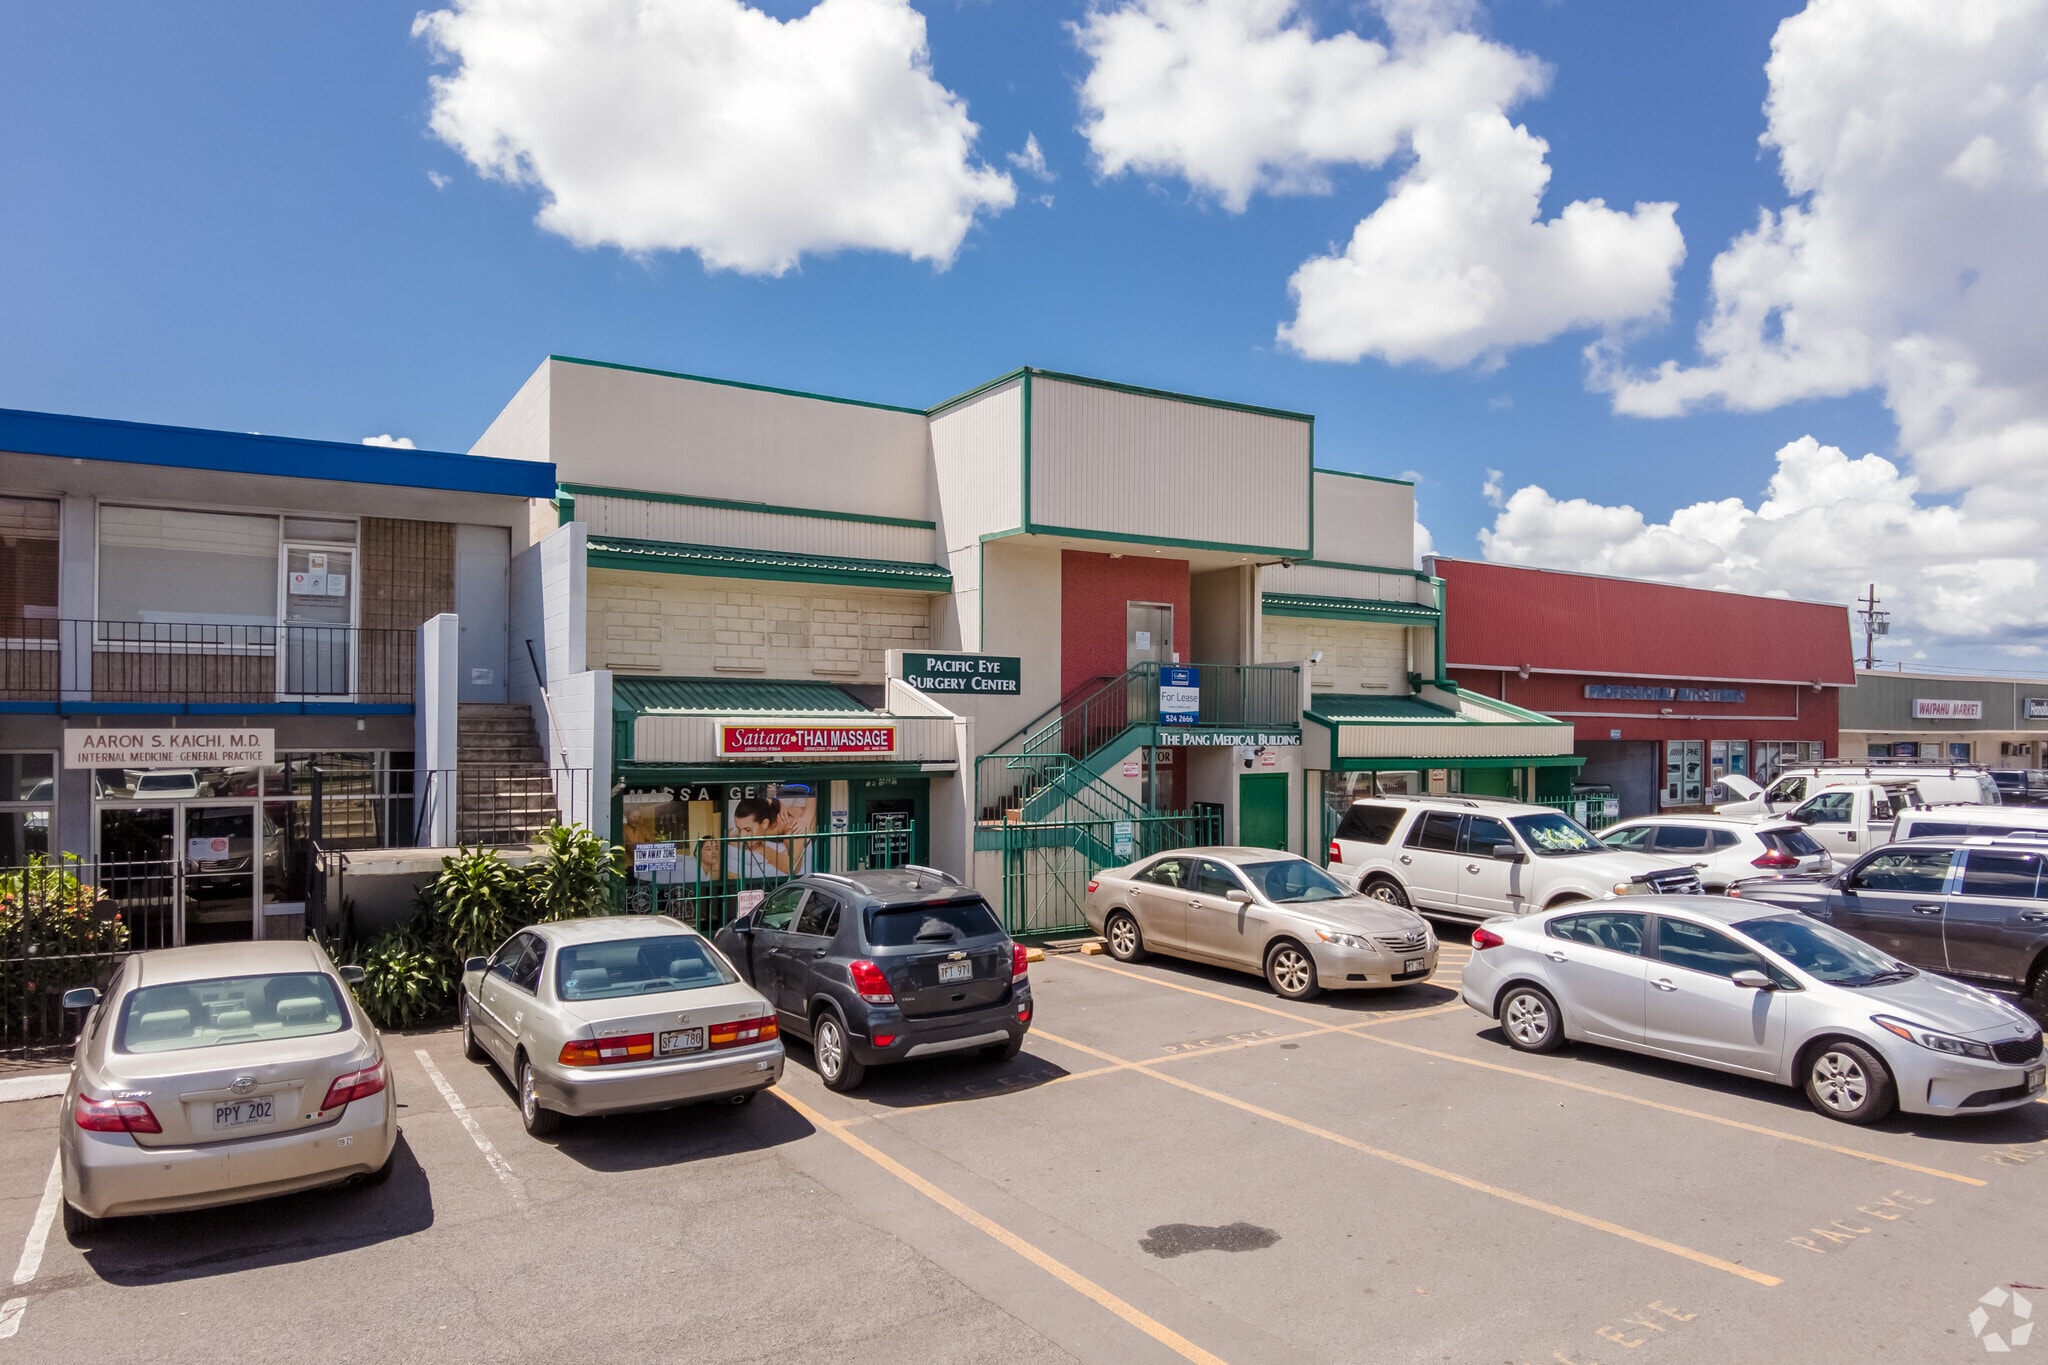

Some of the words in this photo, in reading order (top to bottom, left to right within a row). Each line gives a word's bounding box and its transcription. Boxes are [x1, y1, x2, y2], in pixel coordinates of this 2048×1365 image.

[927, 658, 974, 673] PACIFIC
[979, 660, 1000, 673] EYE
[908, 674, 966, 689] SURGERY
[971, 676, 1016, 691] CENTER
[1161, 692, 1174, 702] For
[1177, 692, 1198, 702] Lease
[1919, 702, 1950, 715] WAIPAHU
[1953, 703, 1979, 716] MARKET
[1178, 715, 1194, 723] 2666
[83, 735, 144, 748] AARON
[151, 735, 165, 747] S.
[230, 735, 260, 747] M.D.
[732, 728, 791, 747] Saitara
[795, 730, 827, 746] THAI
[830, 730, 888, 746] MASSAGE
[1160, 733, 1180, 746] THE
[1183, 733, 1210, 746] PANG
[1212, 733, 1254, 746] MEDICAL
[1258, 733, 1300, 746] BUILDING
[78, 752, 126, 763] INTERNAL
[130, 752, 173, 762] MEDICINE
[180, 752, 219, 761] GENERAL
[222, 751, 263, 761] PRACTICE
[636, 850, 647, 859] TOW
[648, 850, 662, 858] AWAY
[663, 849, 675, 858] ZONE
[662, 1035, 678, 1049] SFZ
[685, 1032, 701, 1045] 780
[216, 1106, 240, 1124] PPY
[248, 1102, 271, 1119] 202
[1786, 1219, 1872, 1254] PAC
[1856, 1190, 1937, 1221] EYE
[1595, 1300, 1697, 1348] EYE
